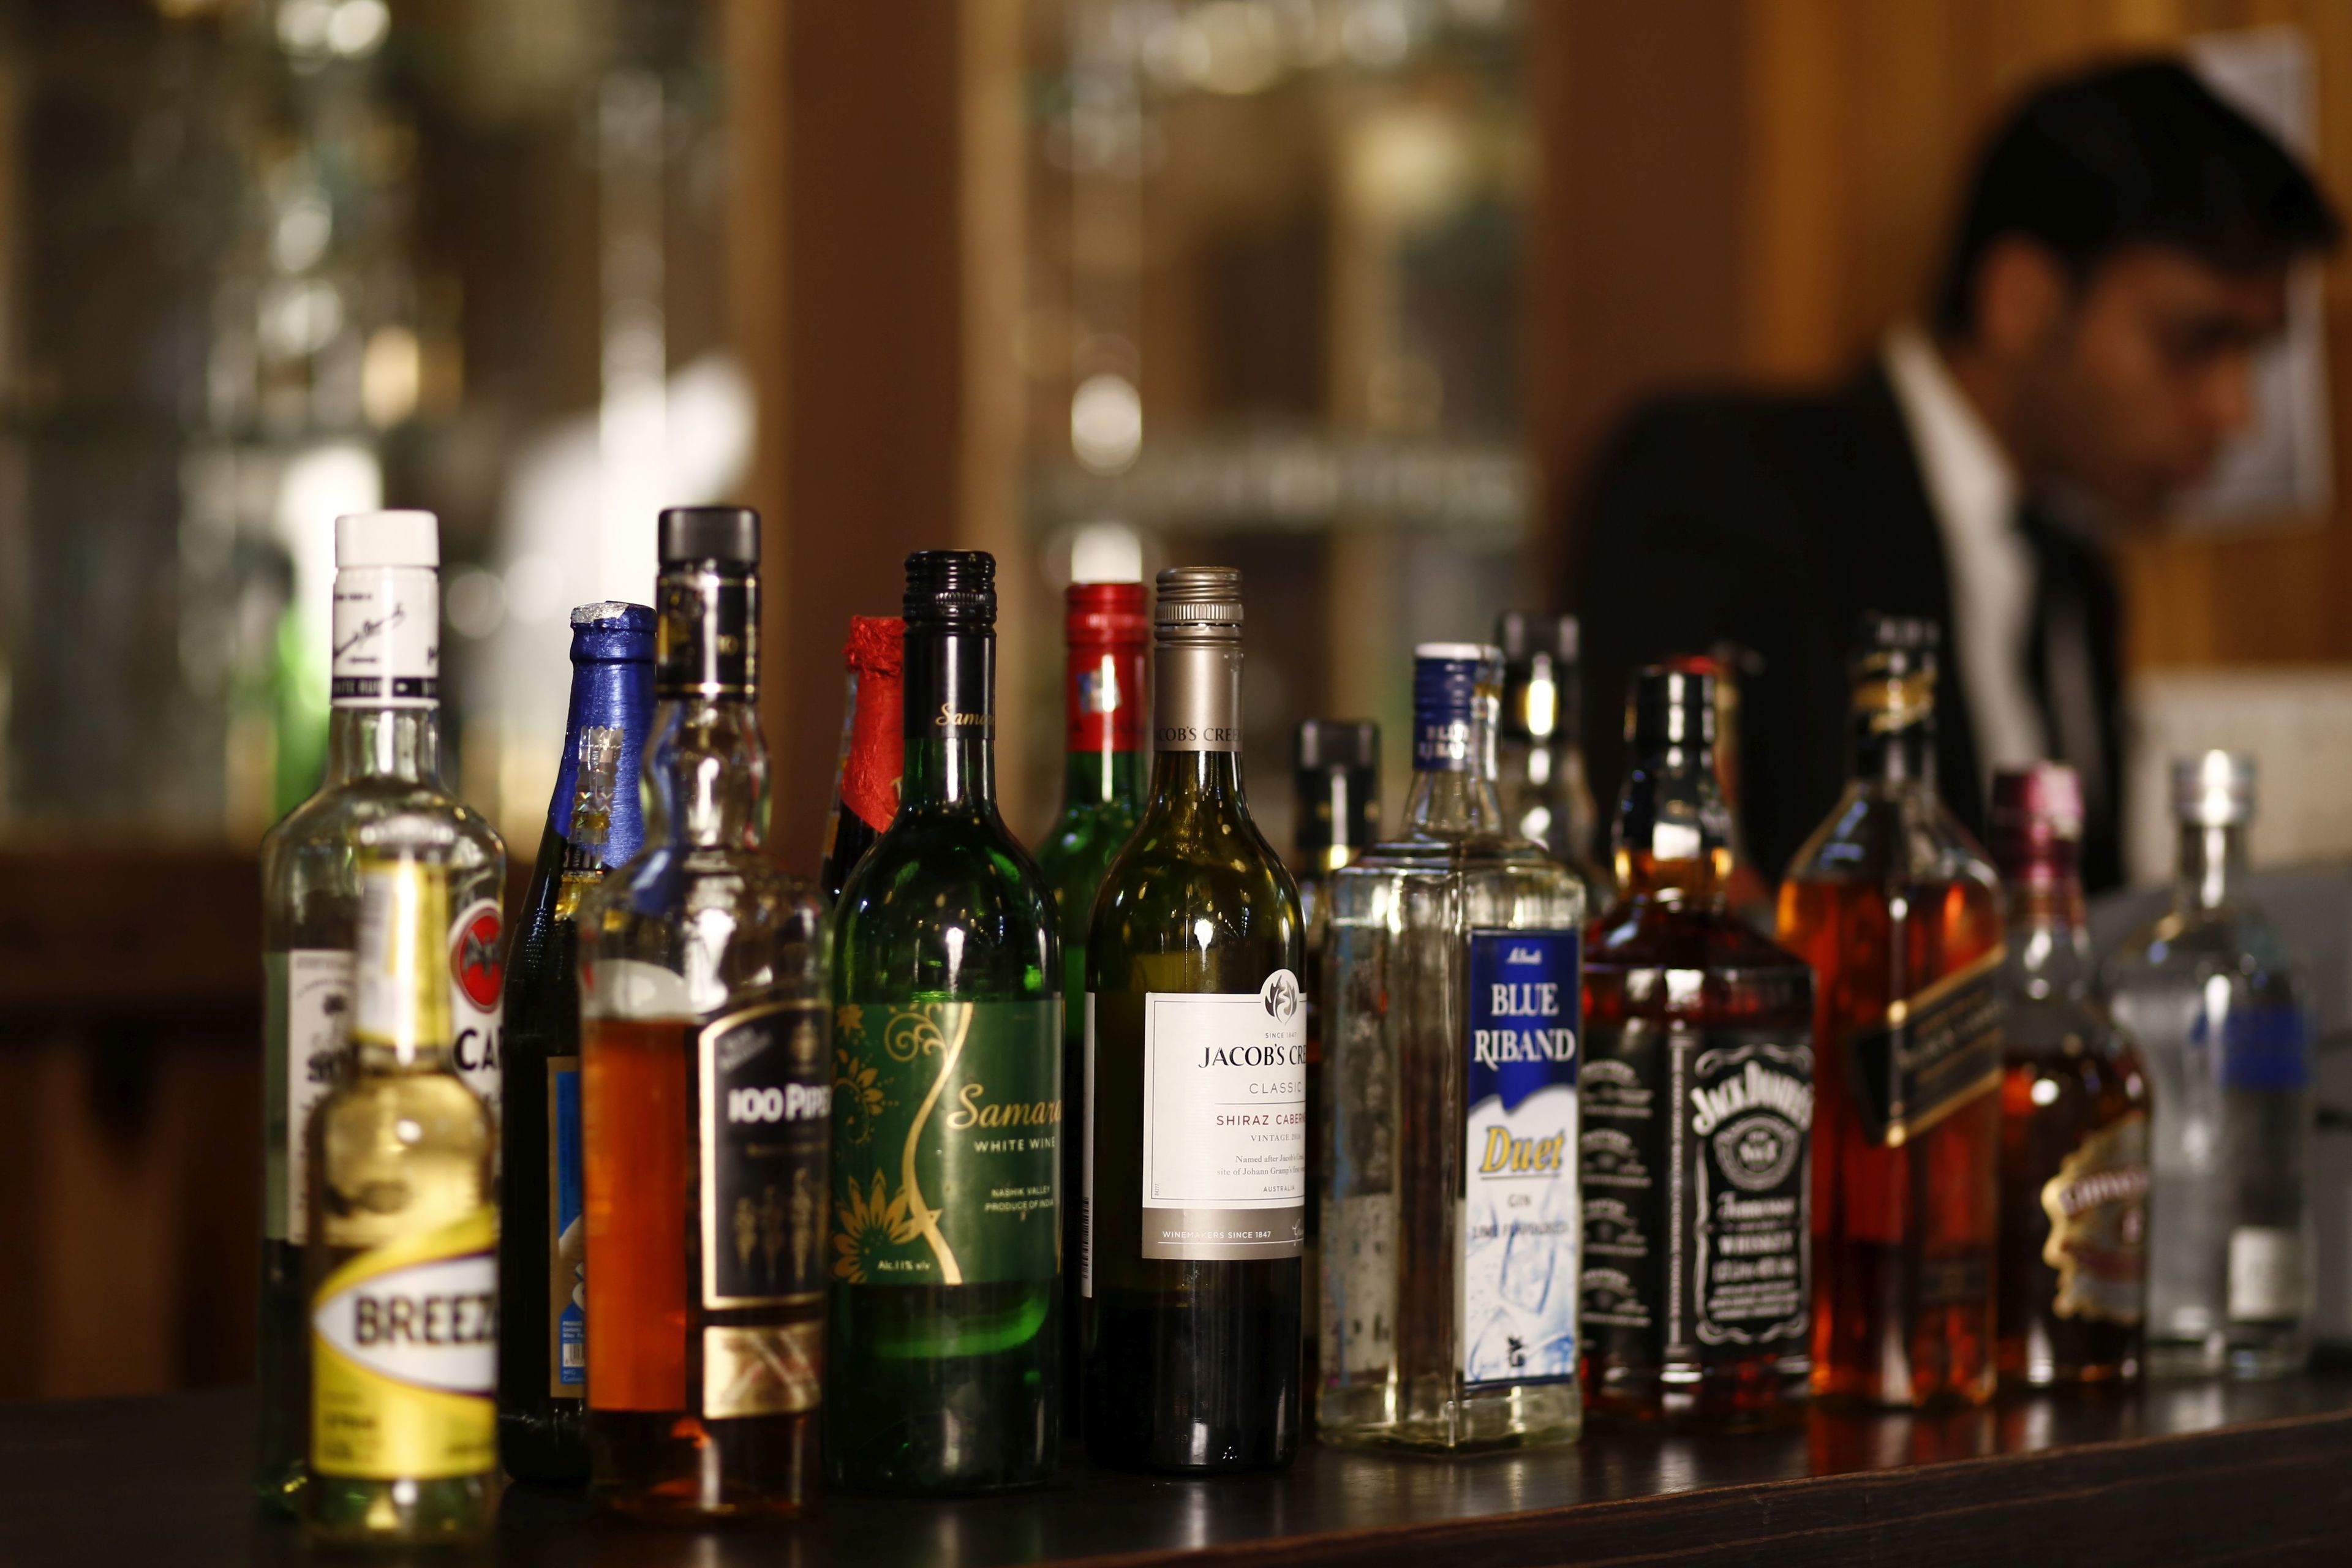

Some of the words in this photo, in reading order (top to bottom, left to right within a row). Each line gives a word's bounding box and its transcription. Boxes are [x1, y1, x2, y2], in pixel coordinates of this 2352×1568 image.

[1157, 726, 1197, 742] COB'S
[1491, 982, 1559, 1017] BLUE
[1198, 1043, 1284, 1068] JACOB'S
[1474, 1028, 1576, 1071] RIBAND
[1249, 1082, 1302, 1095] CLASSIC
[728, 1087, 783, 1123] 100
[1216, 1115, 1270, 1126] SHIRAZ
[974, 1139, 1025, 1153] WHITE
[1029, 1136, 1055, 1149] WINE
[1250, 1134, 1289, 1142] VINTAGE
[1480, 1126, 1564, 1173] Duet
